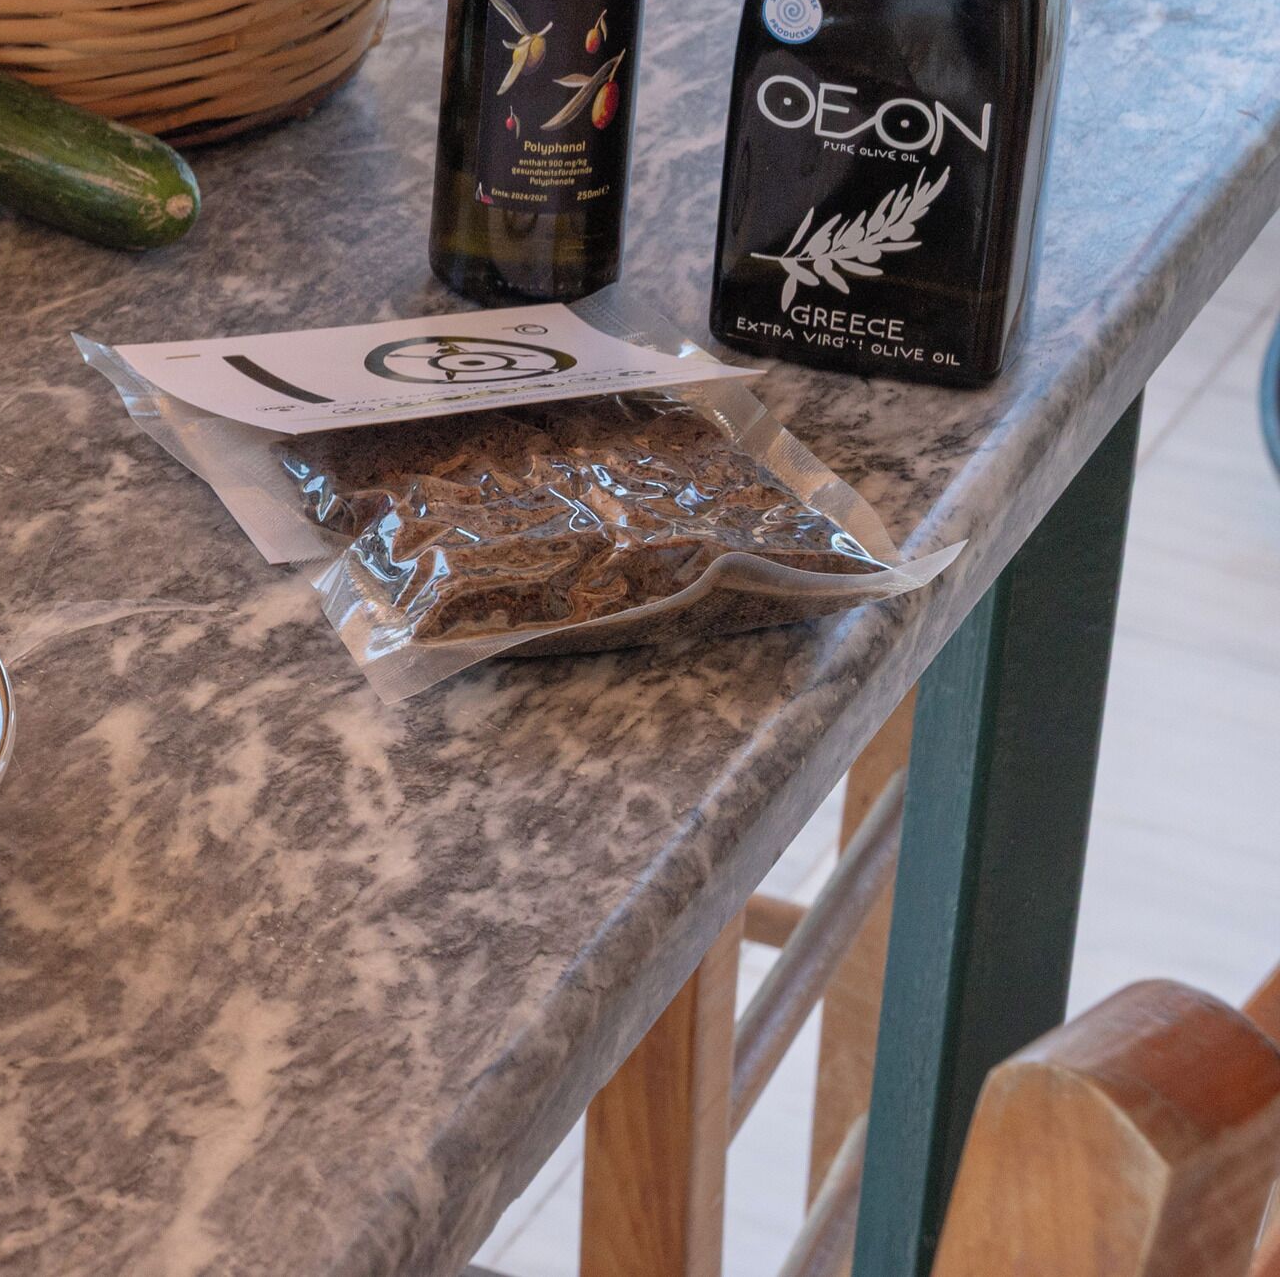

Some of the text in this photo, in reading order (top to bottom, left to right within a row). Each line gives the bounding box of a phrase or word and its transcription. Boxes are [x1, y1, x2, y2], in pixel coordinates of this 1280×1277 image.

[769, 18, 815, 39] PRODUCERS
[757, 74, 992, 156] OEON
[523, 140, 586, 155] Polyphenol
[823, 140, 920, 163] PURE OLIVE OIL
[790, 304, 905, 341] GREECE
[736, 316, 794, 340] EXTRA
[871, 343, 924, 361] OLIVE
[932, 352, 961, 366] OIL
